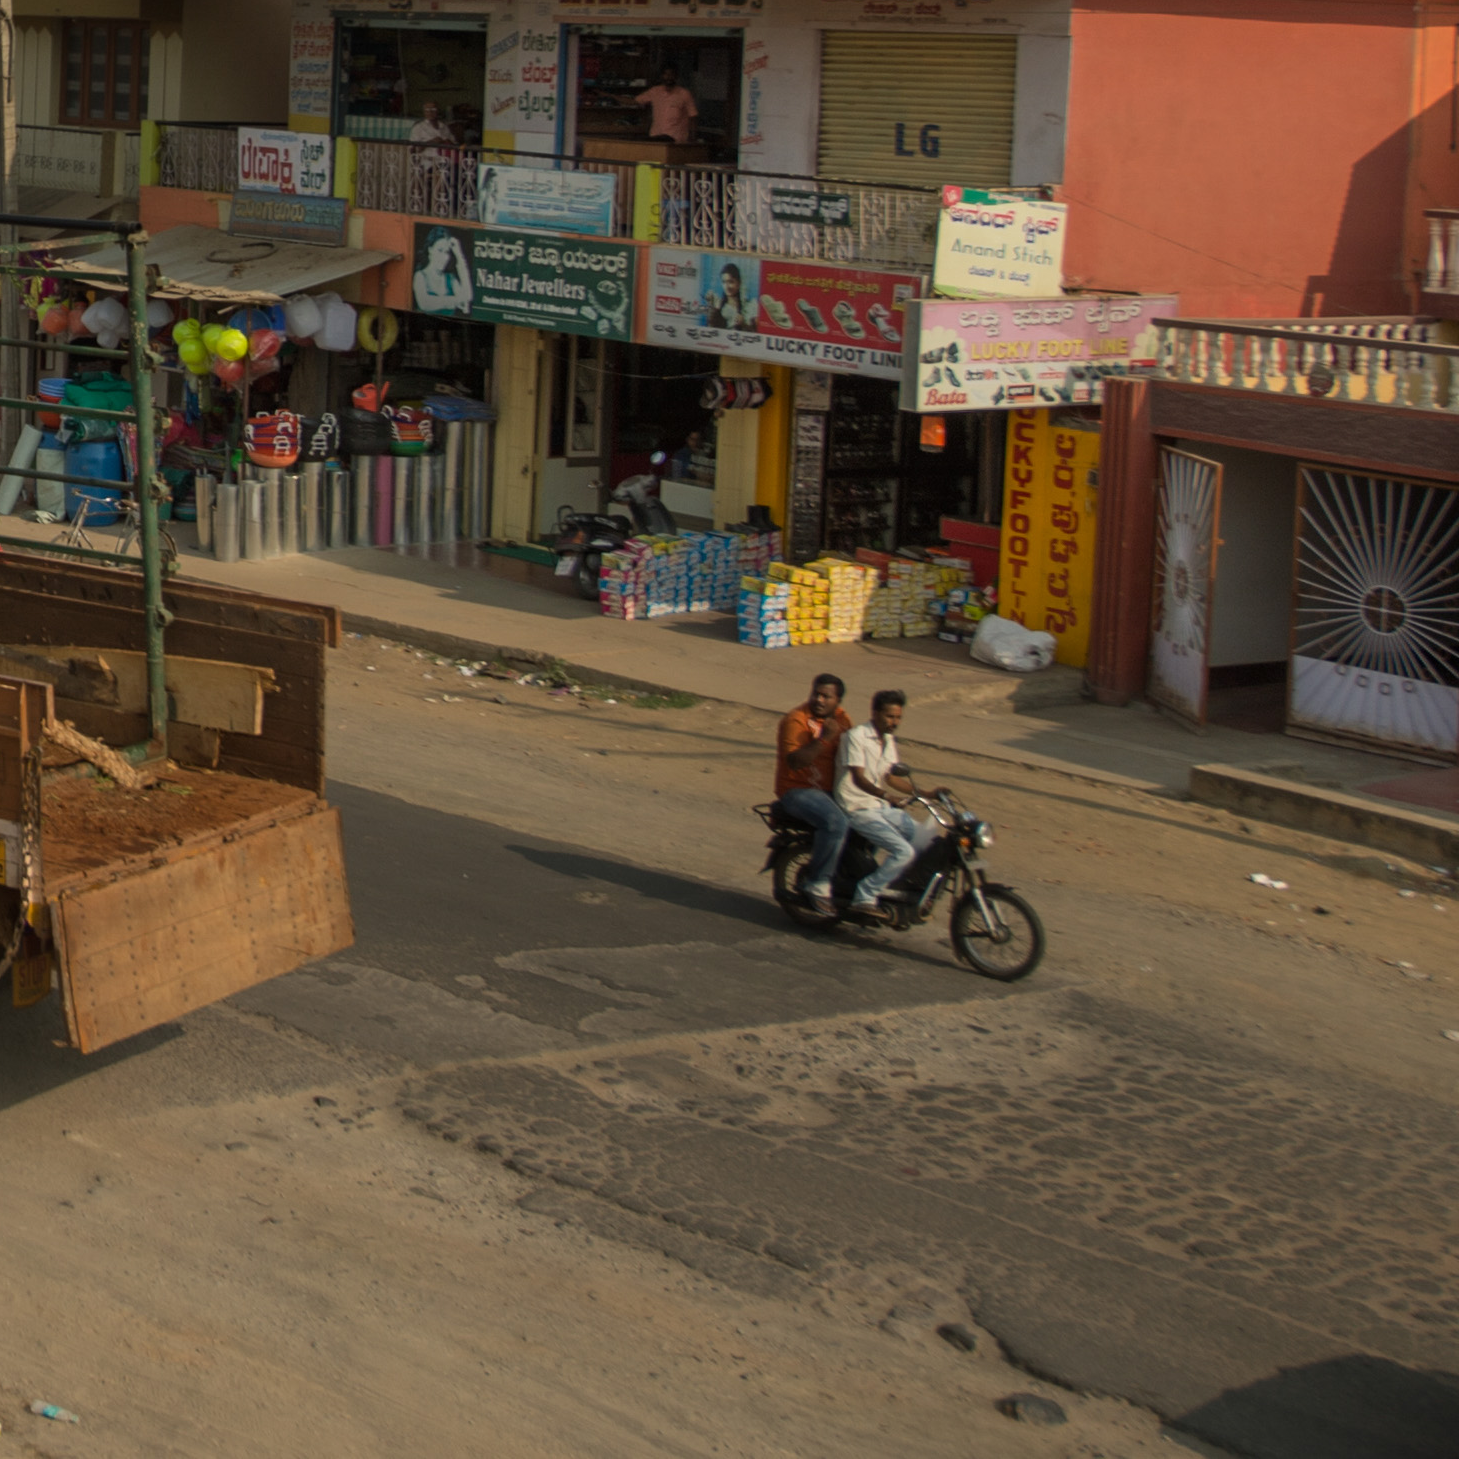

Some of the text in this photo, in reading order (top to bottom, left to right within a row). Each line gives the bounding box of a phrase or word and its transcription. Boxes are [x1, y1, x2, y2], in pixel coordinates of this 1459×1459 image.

[951, 238, 1054, 266] Anand Stich
[476, 267, 587, 301] Nahar Jewellers
[766, 336, 820, 356] LUCKY
[823, 344, 867, 363] FOOT
[870, 351, 903, 369] LIN
[970, 336, 1129, 361] LUCKY FOOT LINE
[923, 388, 969, 407] Bata
[1011, 408, 1036, 489] UCKY
